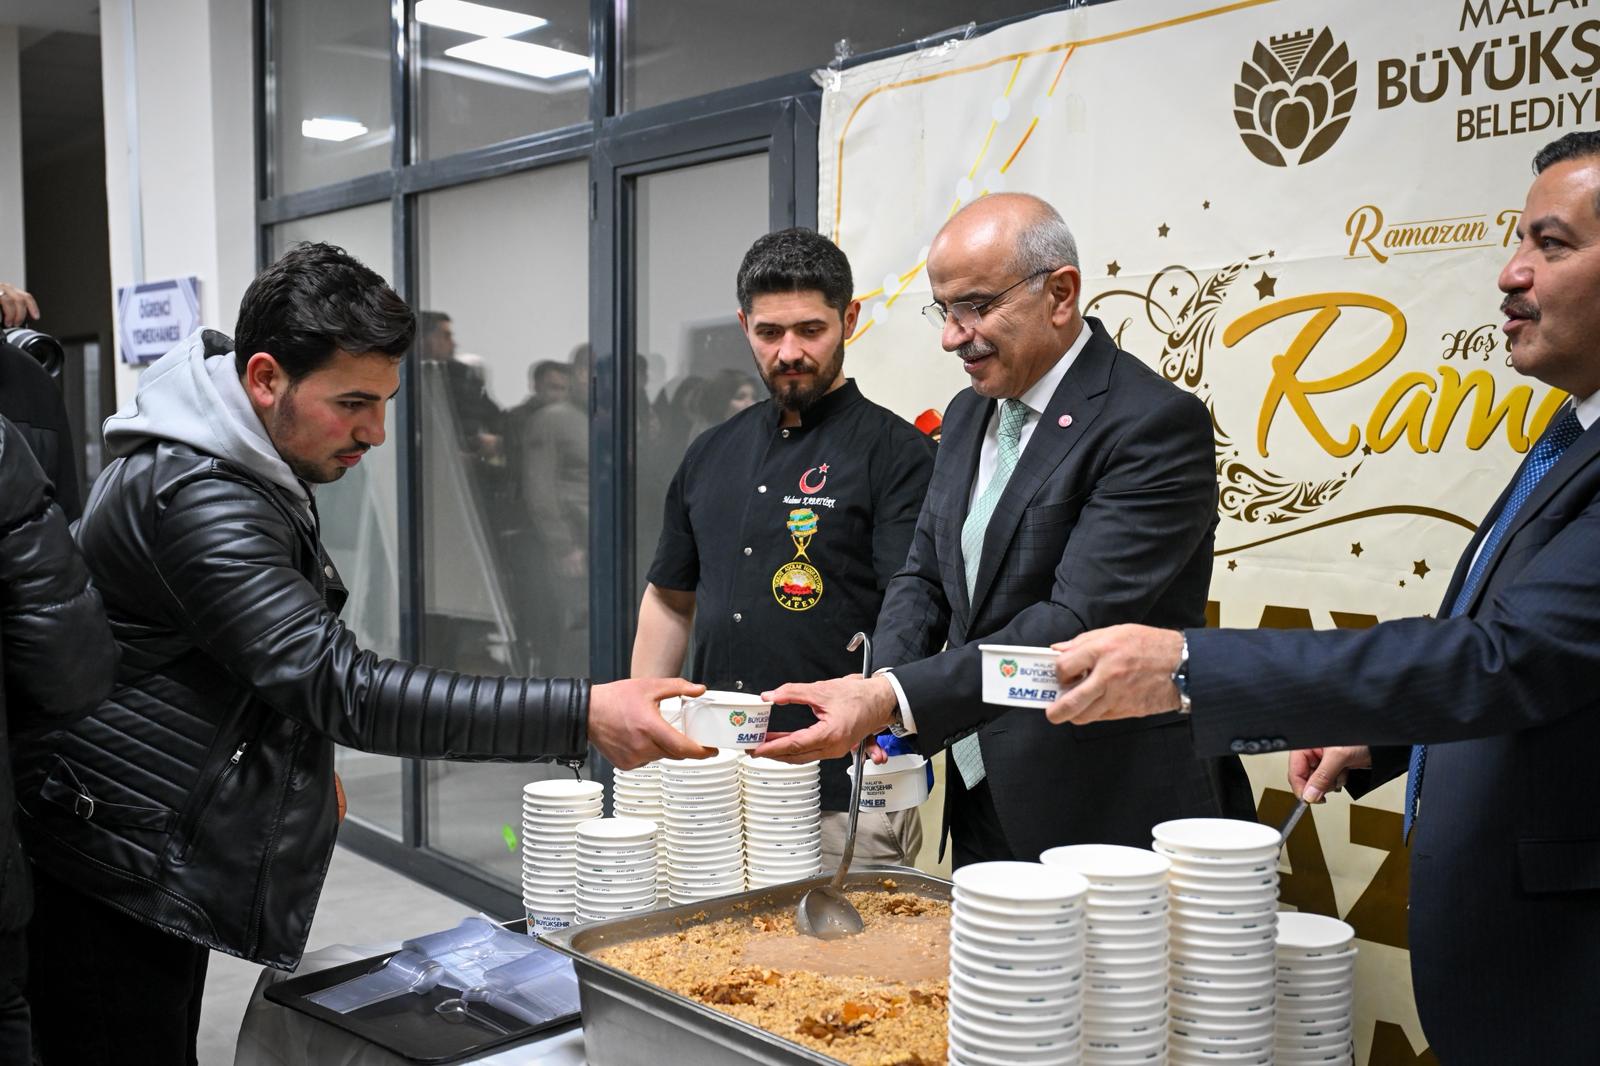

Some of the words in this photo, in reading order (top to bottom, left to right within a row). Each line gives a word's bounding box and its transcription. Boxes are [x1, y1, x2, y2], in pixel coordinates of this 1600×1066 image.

[1457, 88, 1600, 142] BELEDİY
[1345, 204, 1488, 264] Ramazan
[1441, 324, 1498, 361] Hoş
[1008, 687, 1038, 698] SAMİ
[1040, 690, 1057, 700] ER
[737, 733, 758, 742] SAMİ
